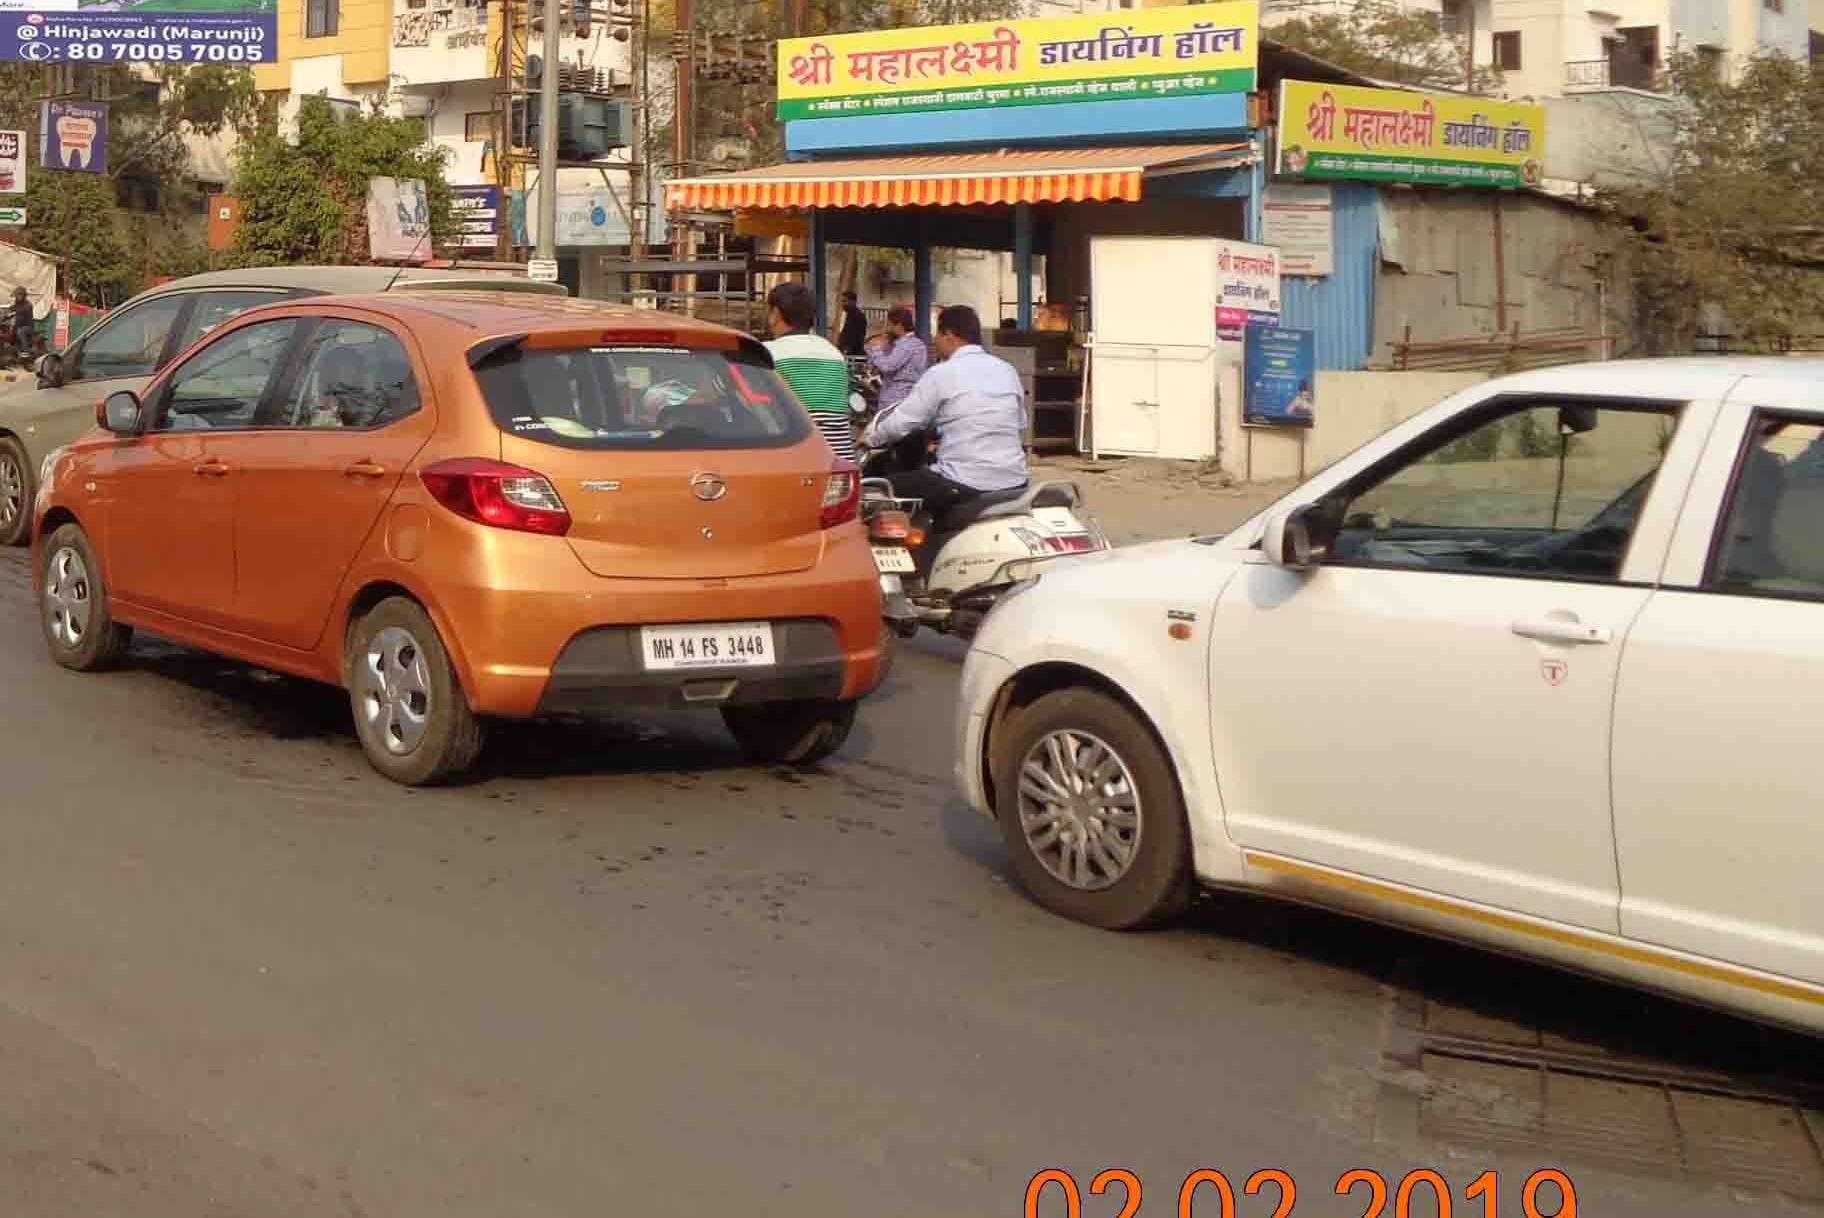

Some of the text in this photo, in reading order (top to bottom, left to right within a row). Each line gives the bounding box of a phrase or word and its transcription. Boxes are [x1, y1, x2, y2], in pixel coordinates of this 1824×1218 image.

[17, 25, 265, 42] @ Hinjawadi (Marunji)
[68, 44, 263, 61] 80 7005 7005
[788, 22, 1245, 86] श्री महालक्ष्मी डायनिंग हॉल
[1306, 92, 1336, 143] श्री
[1343, 100, 1436, 151] महालक्ष्मी
[653, 636, 763, 659] MH 14 FS 3448
